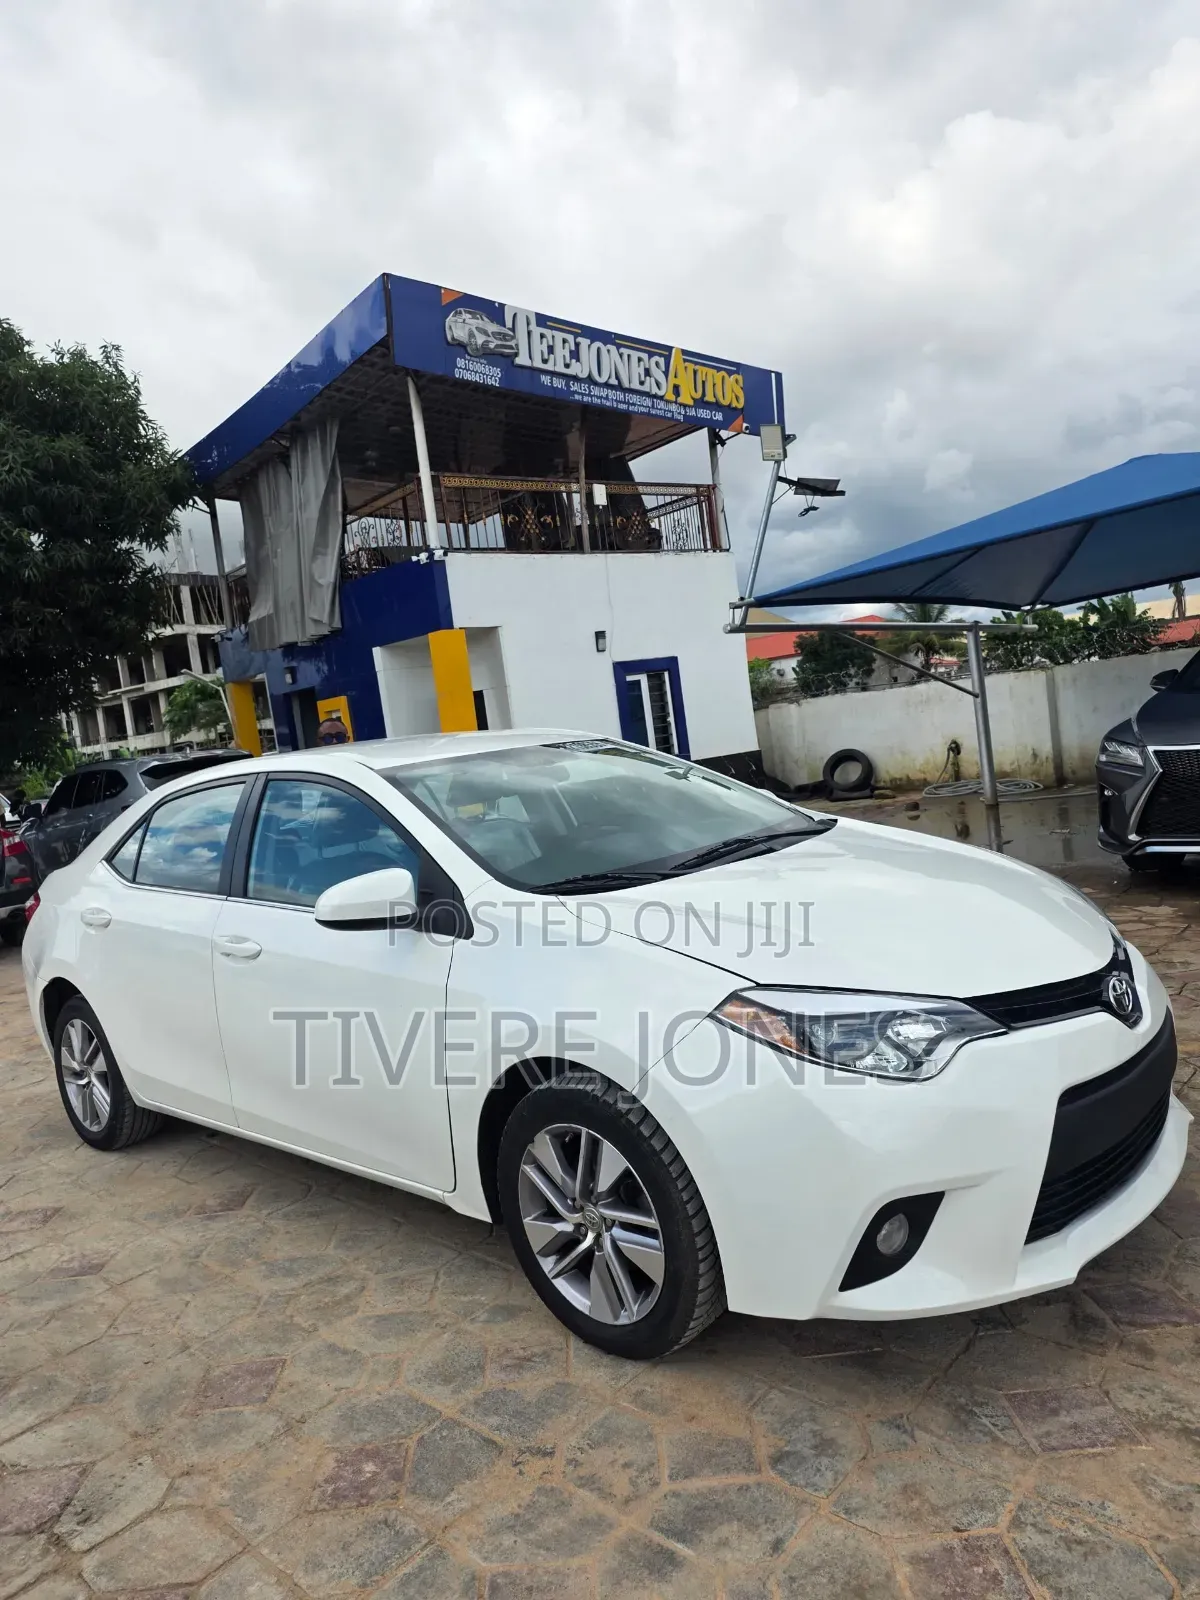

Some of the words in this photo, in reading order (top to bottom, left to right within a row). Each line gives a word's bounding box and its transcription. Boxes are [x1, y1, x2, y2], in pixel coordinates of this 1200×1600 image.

[504, 304, 667, 397] TEEJONES
[664, 346, 745, 409] AUTOS
[454, 368, 500, 387] 07068431642
[456, 357, 502, 378] 08160068305
[540, 374, 551, 386] WE
[569, 381, 589, 394] SALES
[696, 408, 711, 419] USED
[711, 411, 724, 421] CAR
[592, 396, 602, 404] the
